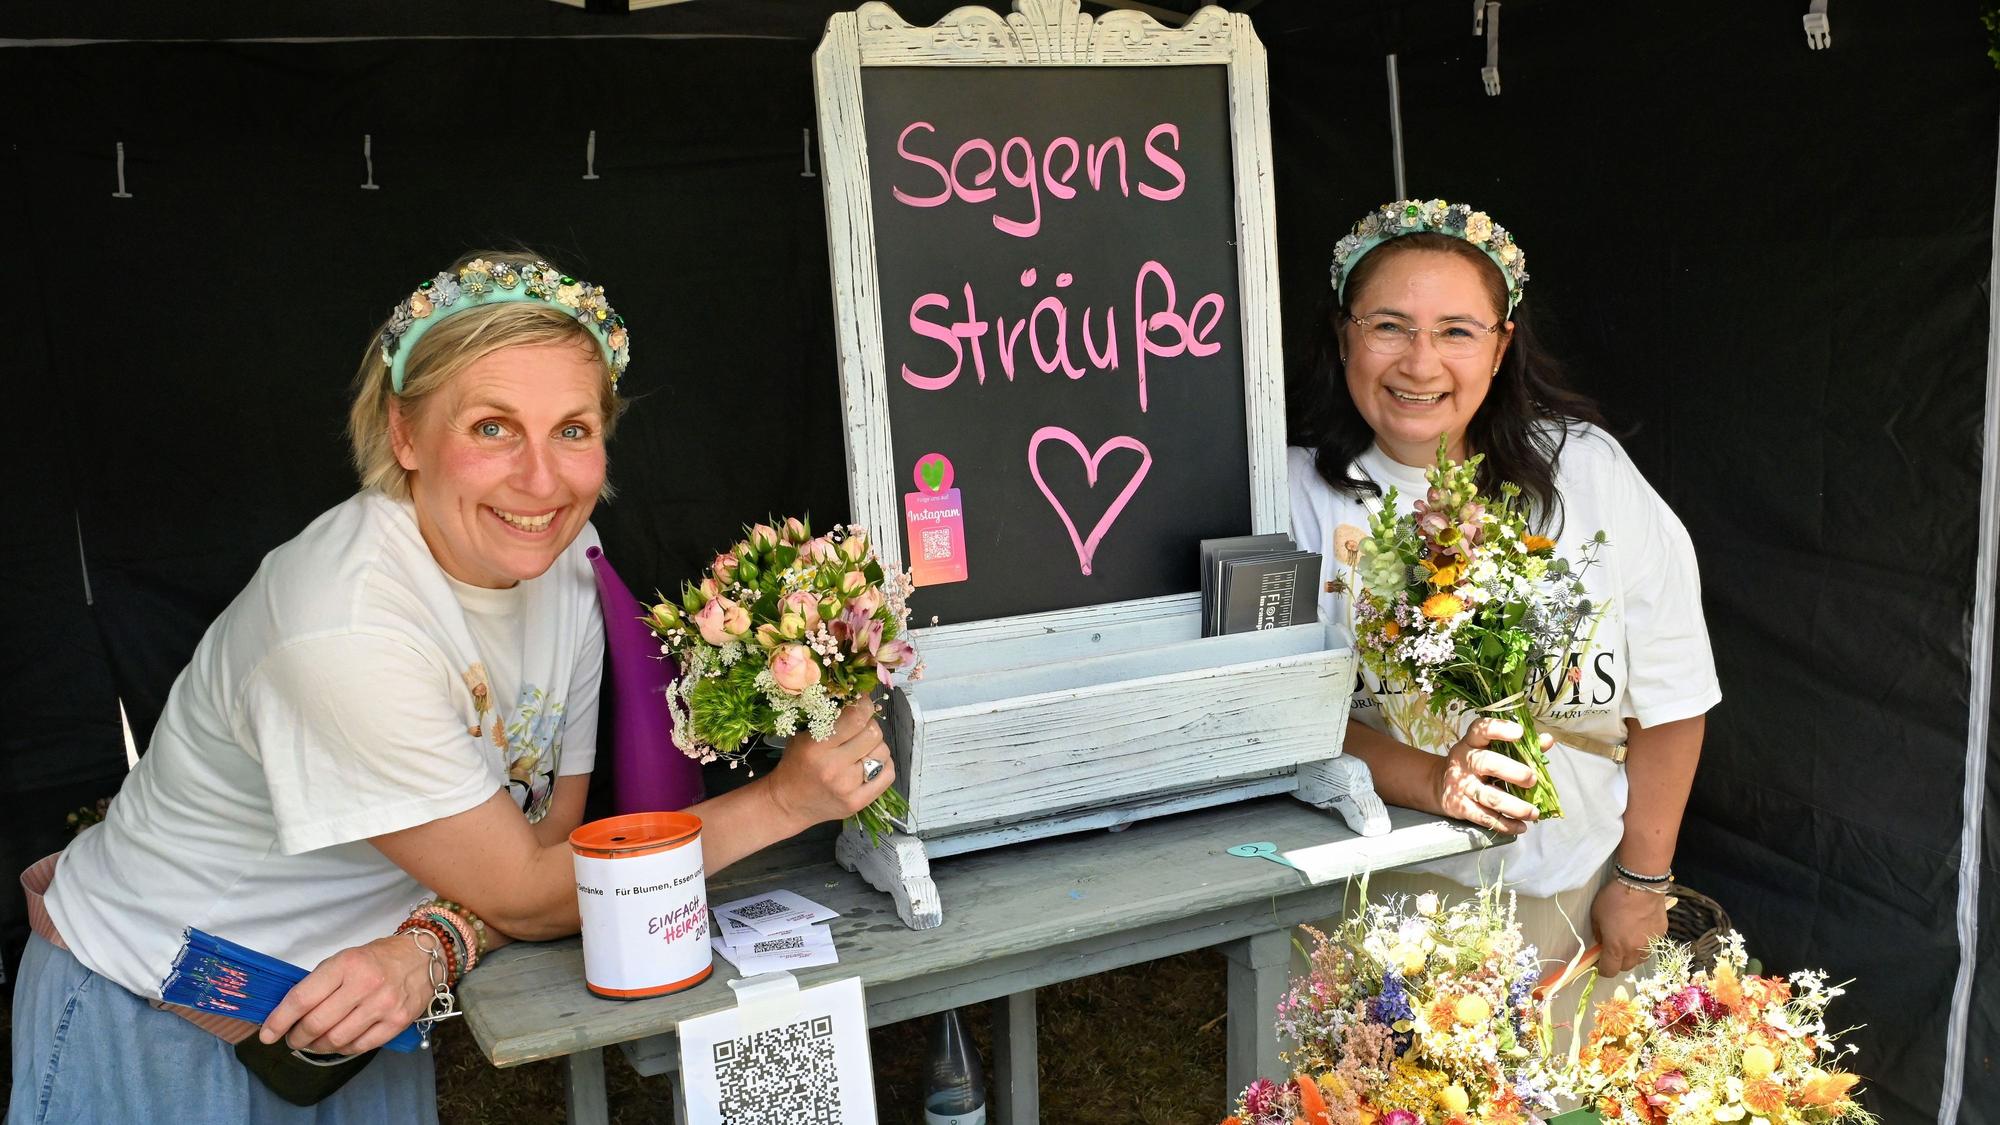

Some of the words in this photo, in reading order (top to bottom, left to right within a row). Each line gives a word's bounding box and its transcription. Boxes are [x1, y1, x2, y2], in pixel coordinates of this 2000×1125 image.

[893, 121, 1186, 238] Segens
[901, 260, 1225, 413] Sträuße
[907, 508, 961, 524] Instagram
[615, 888, 631, 896] Für
[633, 883, 672, 895] Blumen,
[673, 873, 694, 887] Essen
[648, 895, 700, 935] EINFACH
[663, 903, 707, 945] HEIRATE
